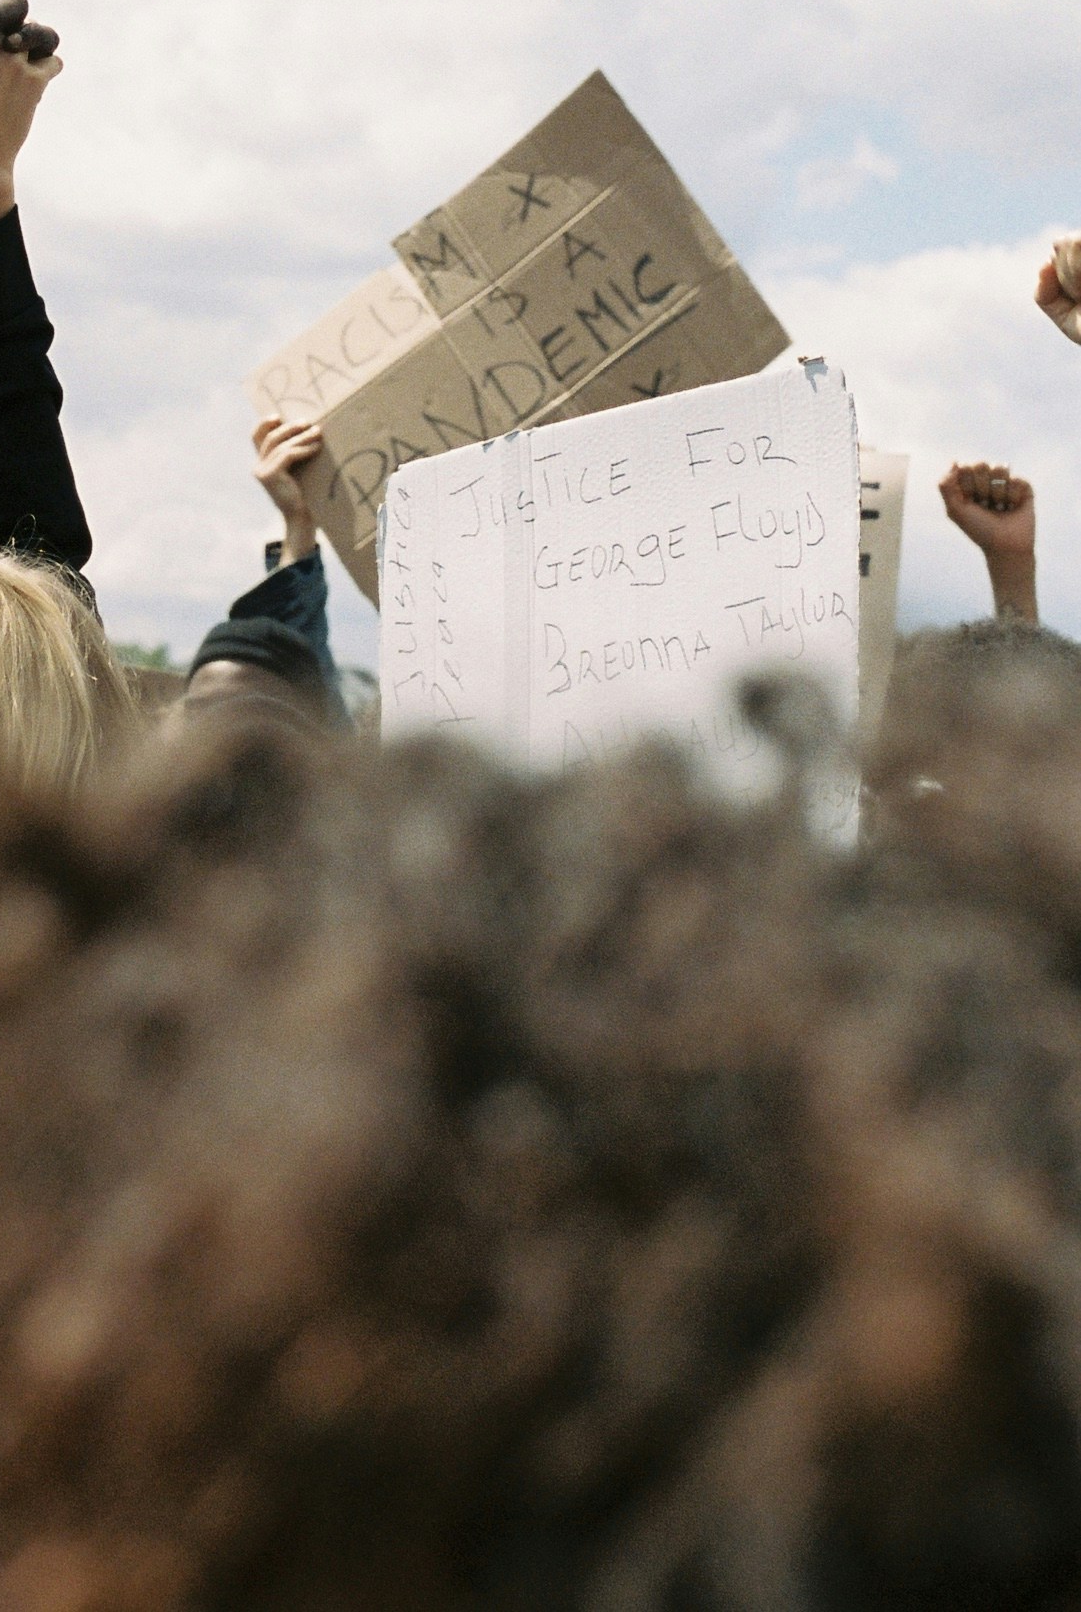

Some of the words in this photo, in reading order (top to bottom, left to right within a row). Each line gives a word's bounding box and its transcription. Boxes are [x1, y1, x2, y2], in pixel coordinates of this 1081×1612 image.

[258, 231, 478, 418] RACISM
[469, 285, 528, 337] IS
[562, 228, 608, 279] A
[325, 253, 677, 506] PANDEMIC
[685, 427, 797, 478] FOR
